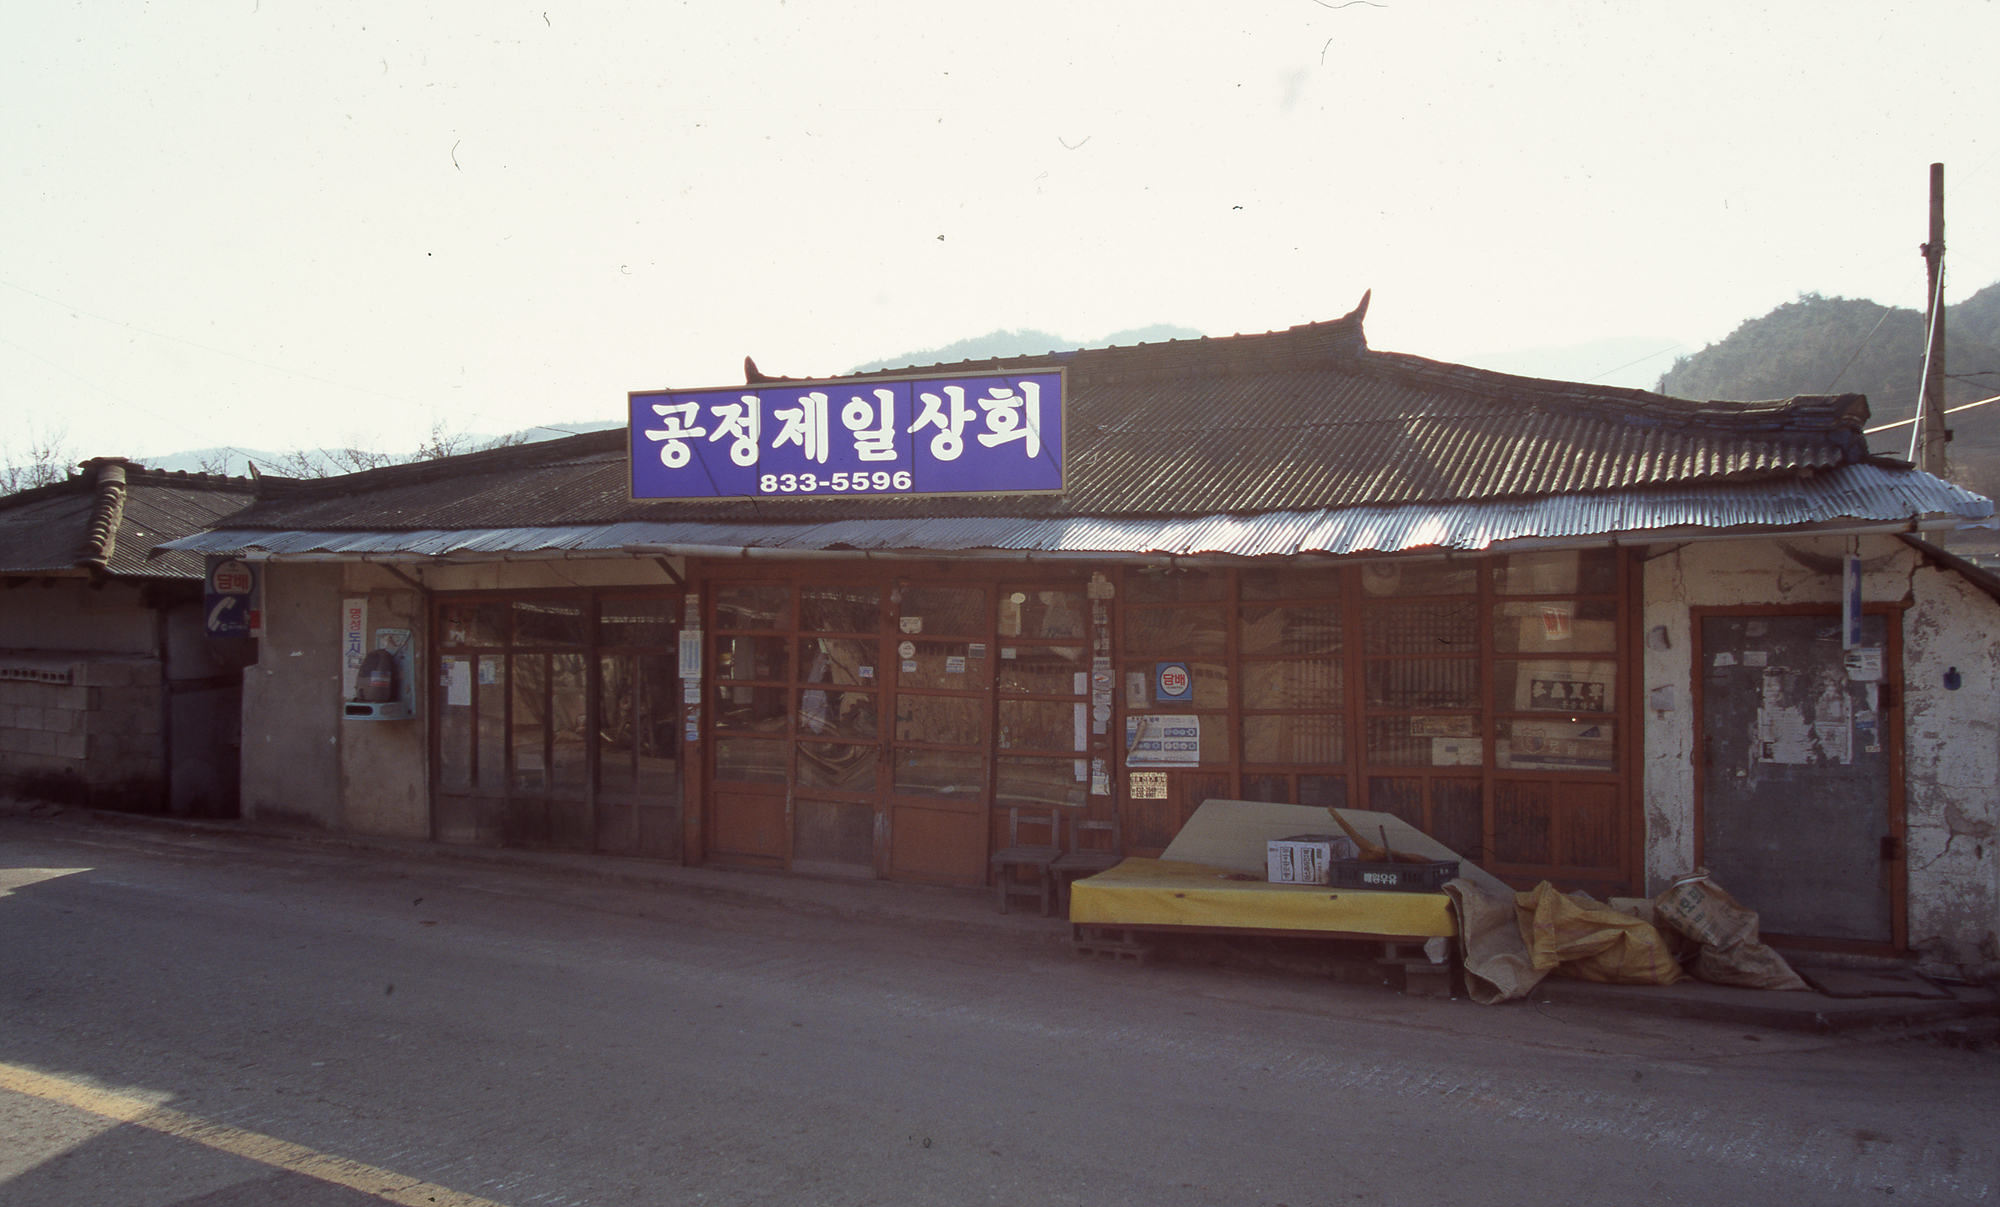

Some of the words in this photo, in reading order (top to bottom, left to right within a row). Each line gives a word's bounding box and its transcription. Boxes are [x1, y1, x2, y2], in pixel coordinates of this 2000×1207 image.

[645, 381, 1041, 468] 공정제일상회
[760, 471, 912, 492] 833-5596
[217, 574, 249, 590] 담배
[1163, 674, 1186, 686] 담배
